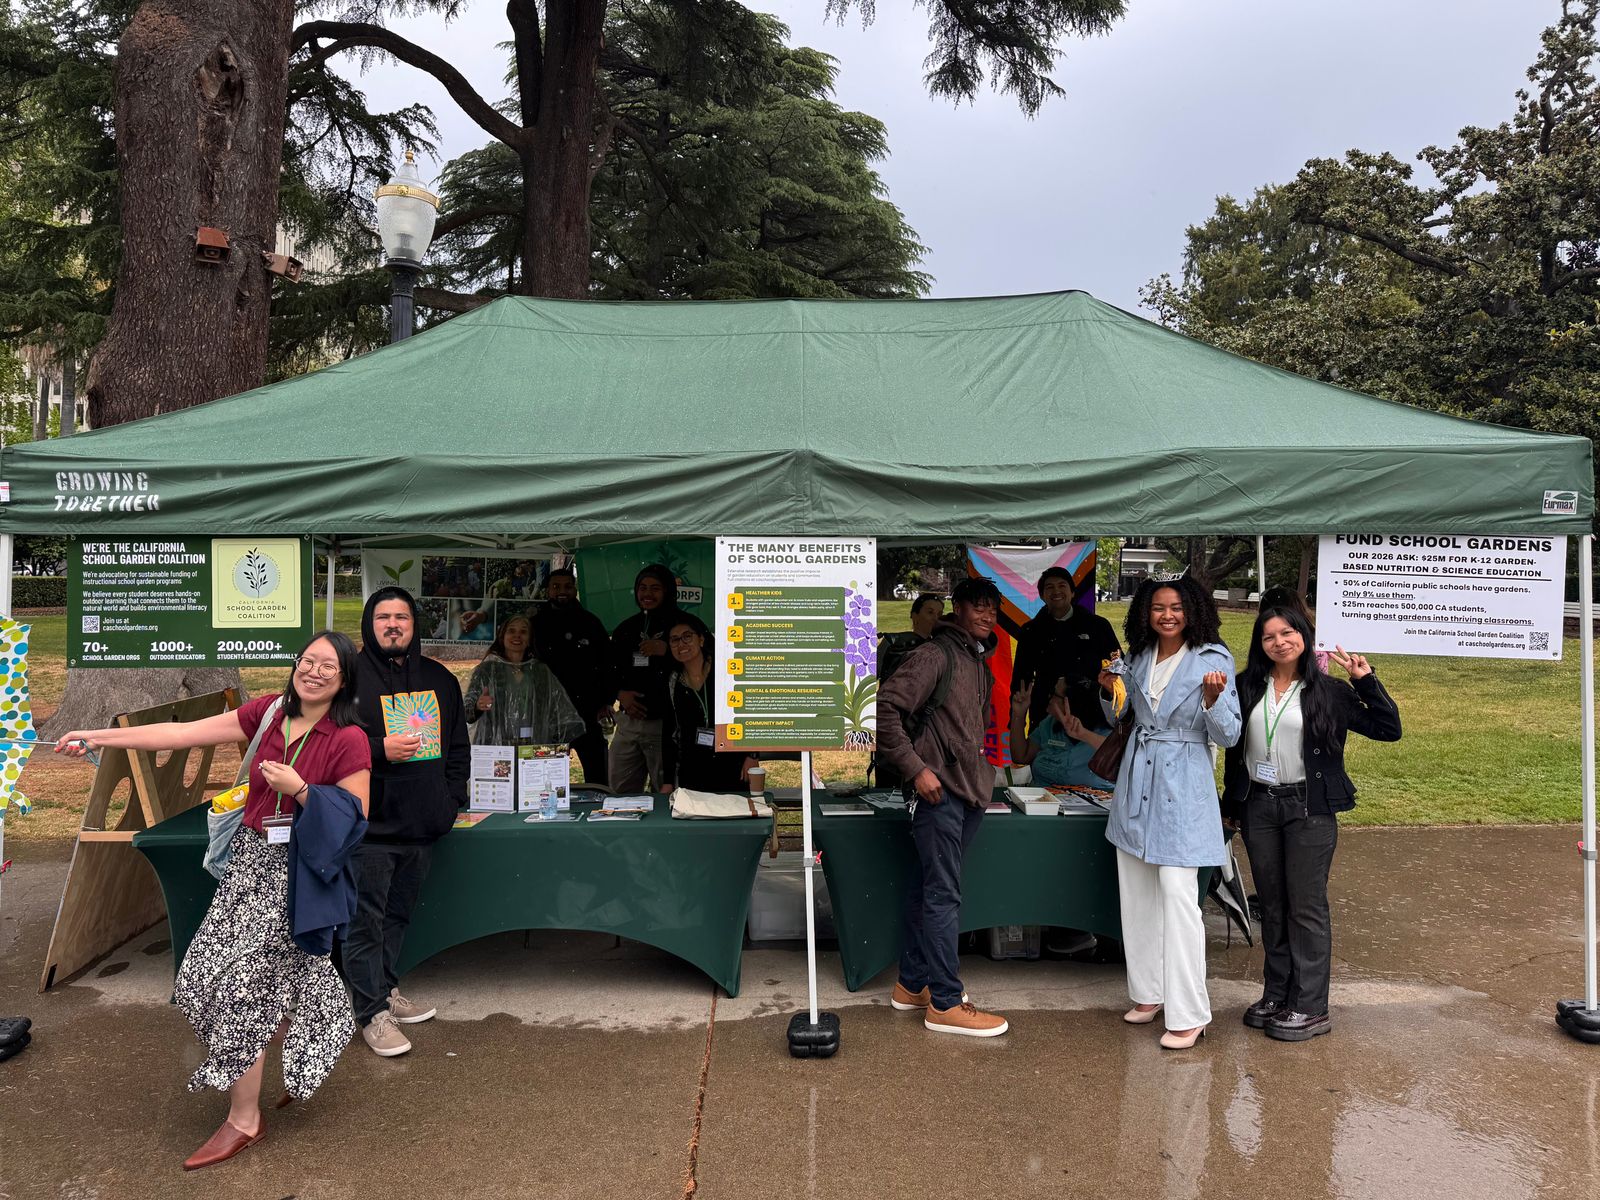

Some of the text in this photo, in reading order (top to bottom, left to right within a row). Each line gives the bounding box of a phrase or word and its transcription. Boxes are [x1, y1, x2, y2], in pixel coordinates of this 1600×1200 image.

[56, 472, 148, 491] GROWING
[54, 494, 160, 512] TOGETHER
[1544, 499, 1573, 510] Eurmax
[82, 543, 185, 553] WE'RE THE CALIFORNIA
[728, 544, 861, 552] THE MANY BENEFITS
[1336, 534, 1552, 552] FUND SCHOOL GARDENS
[82, 554, 205, 564] SCHOOL GARDEN COALITION
[728, 555, 866, 564] OF SCHOOL GARDENS
[1376, 565, 1429, 573] NUTRITION
[1486, 569, 1541, 577] EDUCATION
[1412, 582, 1437, 590] public
[676, 591, 700, 600] ORPS
[1341, 611, 1371, 620] turning
[1450, 616, 1482, 624] thriving
[82, 642, 109, 652] 70+
[151, 641, 193, 652] 1000+
[217, 640, 282, 653] 200,000+
[1465, 641, 1525, 650] caschoolgardens.org
